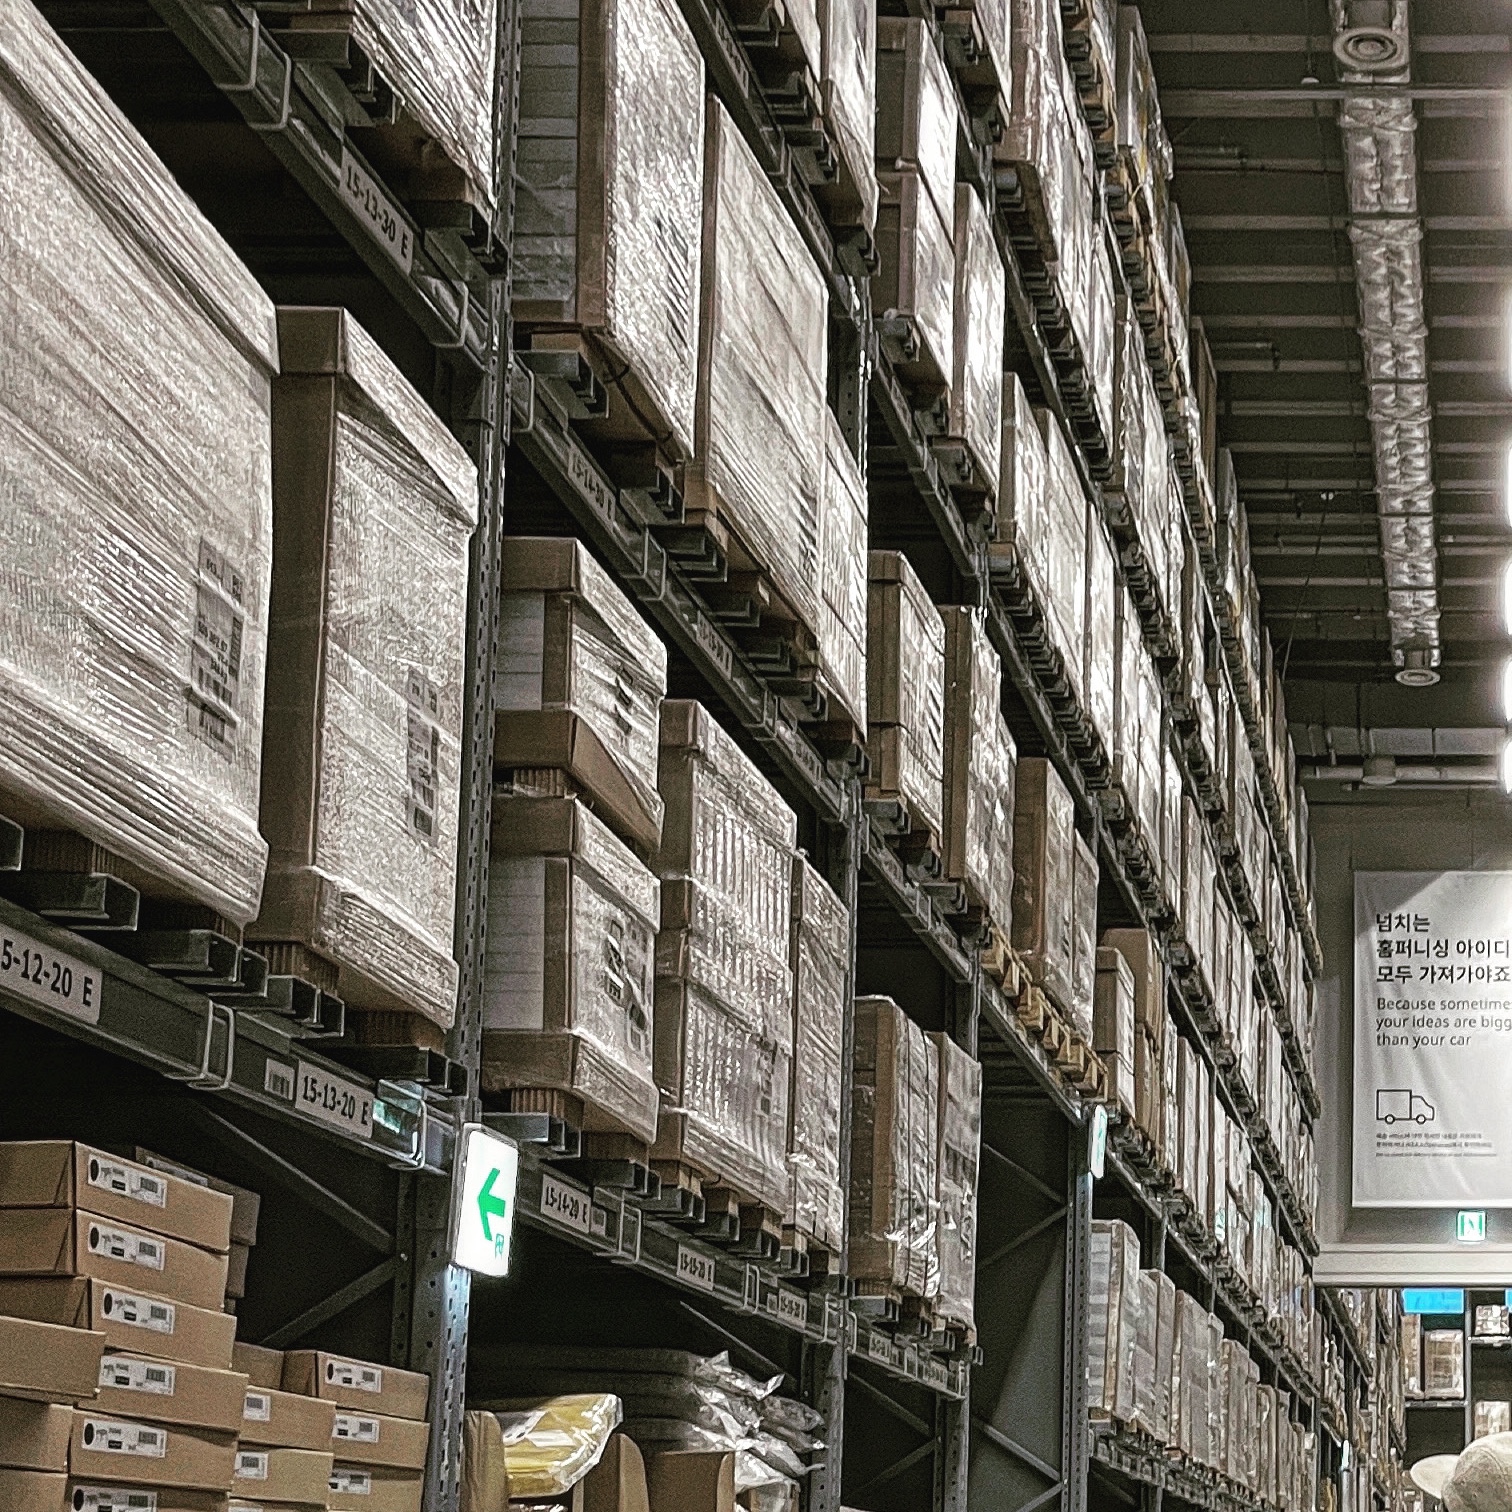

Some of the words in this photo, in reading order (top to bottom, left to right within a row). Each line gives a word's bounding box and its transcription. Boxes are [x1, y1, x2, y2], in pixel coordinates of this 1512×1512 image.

[346, 165, 396, 242] 15-13-30
[401, 231, 408, 259] E
[1376, 912, 1430, 933] 넘치는
[1376, 939, 1450, 959] 홈퍼니싱
[1376, 965, 1413, 984] 모두
[1418, 965, 1511, 984] 가져가야죠
[82, 976, 93, 1007] E
[1377, 997, 1436, 1011] Because
[1375, 1017, 1409, 1032] your
[1411, 1015, 1450, 1029] ideas
[1454, 1017, 1477, 1029] are
[1376, 1033, 1409, 1047] than
[1412, 1035, 1446, 1049] your
[1449, 1035, 1472, 1047] car
[302, 1075, 356, 1120] 15-13-20
[361, 1102, 369, 1126] E
[545, 1186, 579, 1220] 15-14-20
